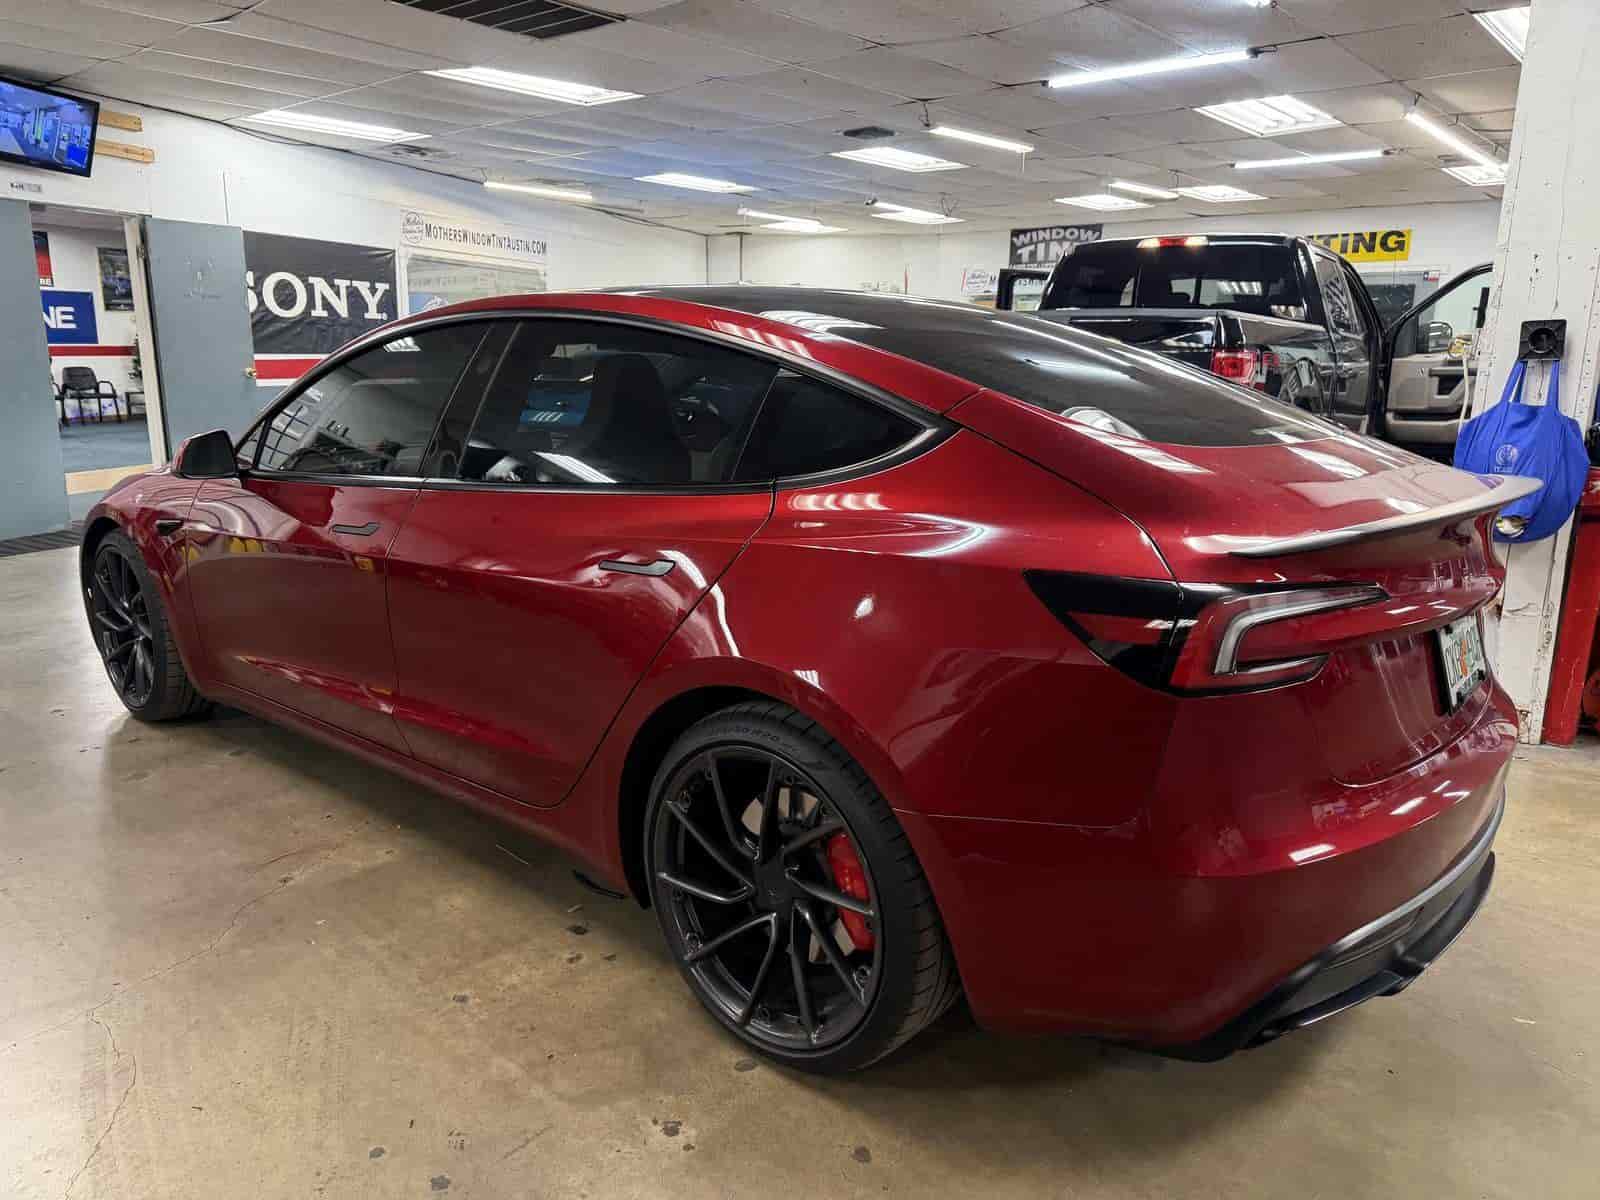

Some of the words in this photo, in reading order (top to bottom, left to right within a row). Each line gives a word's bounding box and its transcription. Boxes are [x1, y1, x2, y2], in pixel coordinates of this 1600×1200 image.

[1011, 227, 1100, 246] WINDOW
[1307, 230, 1406, 253] TING
[1016, 240, 1079, 263] TIN
